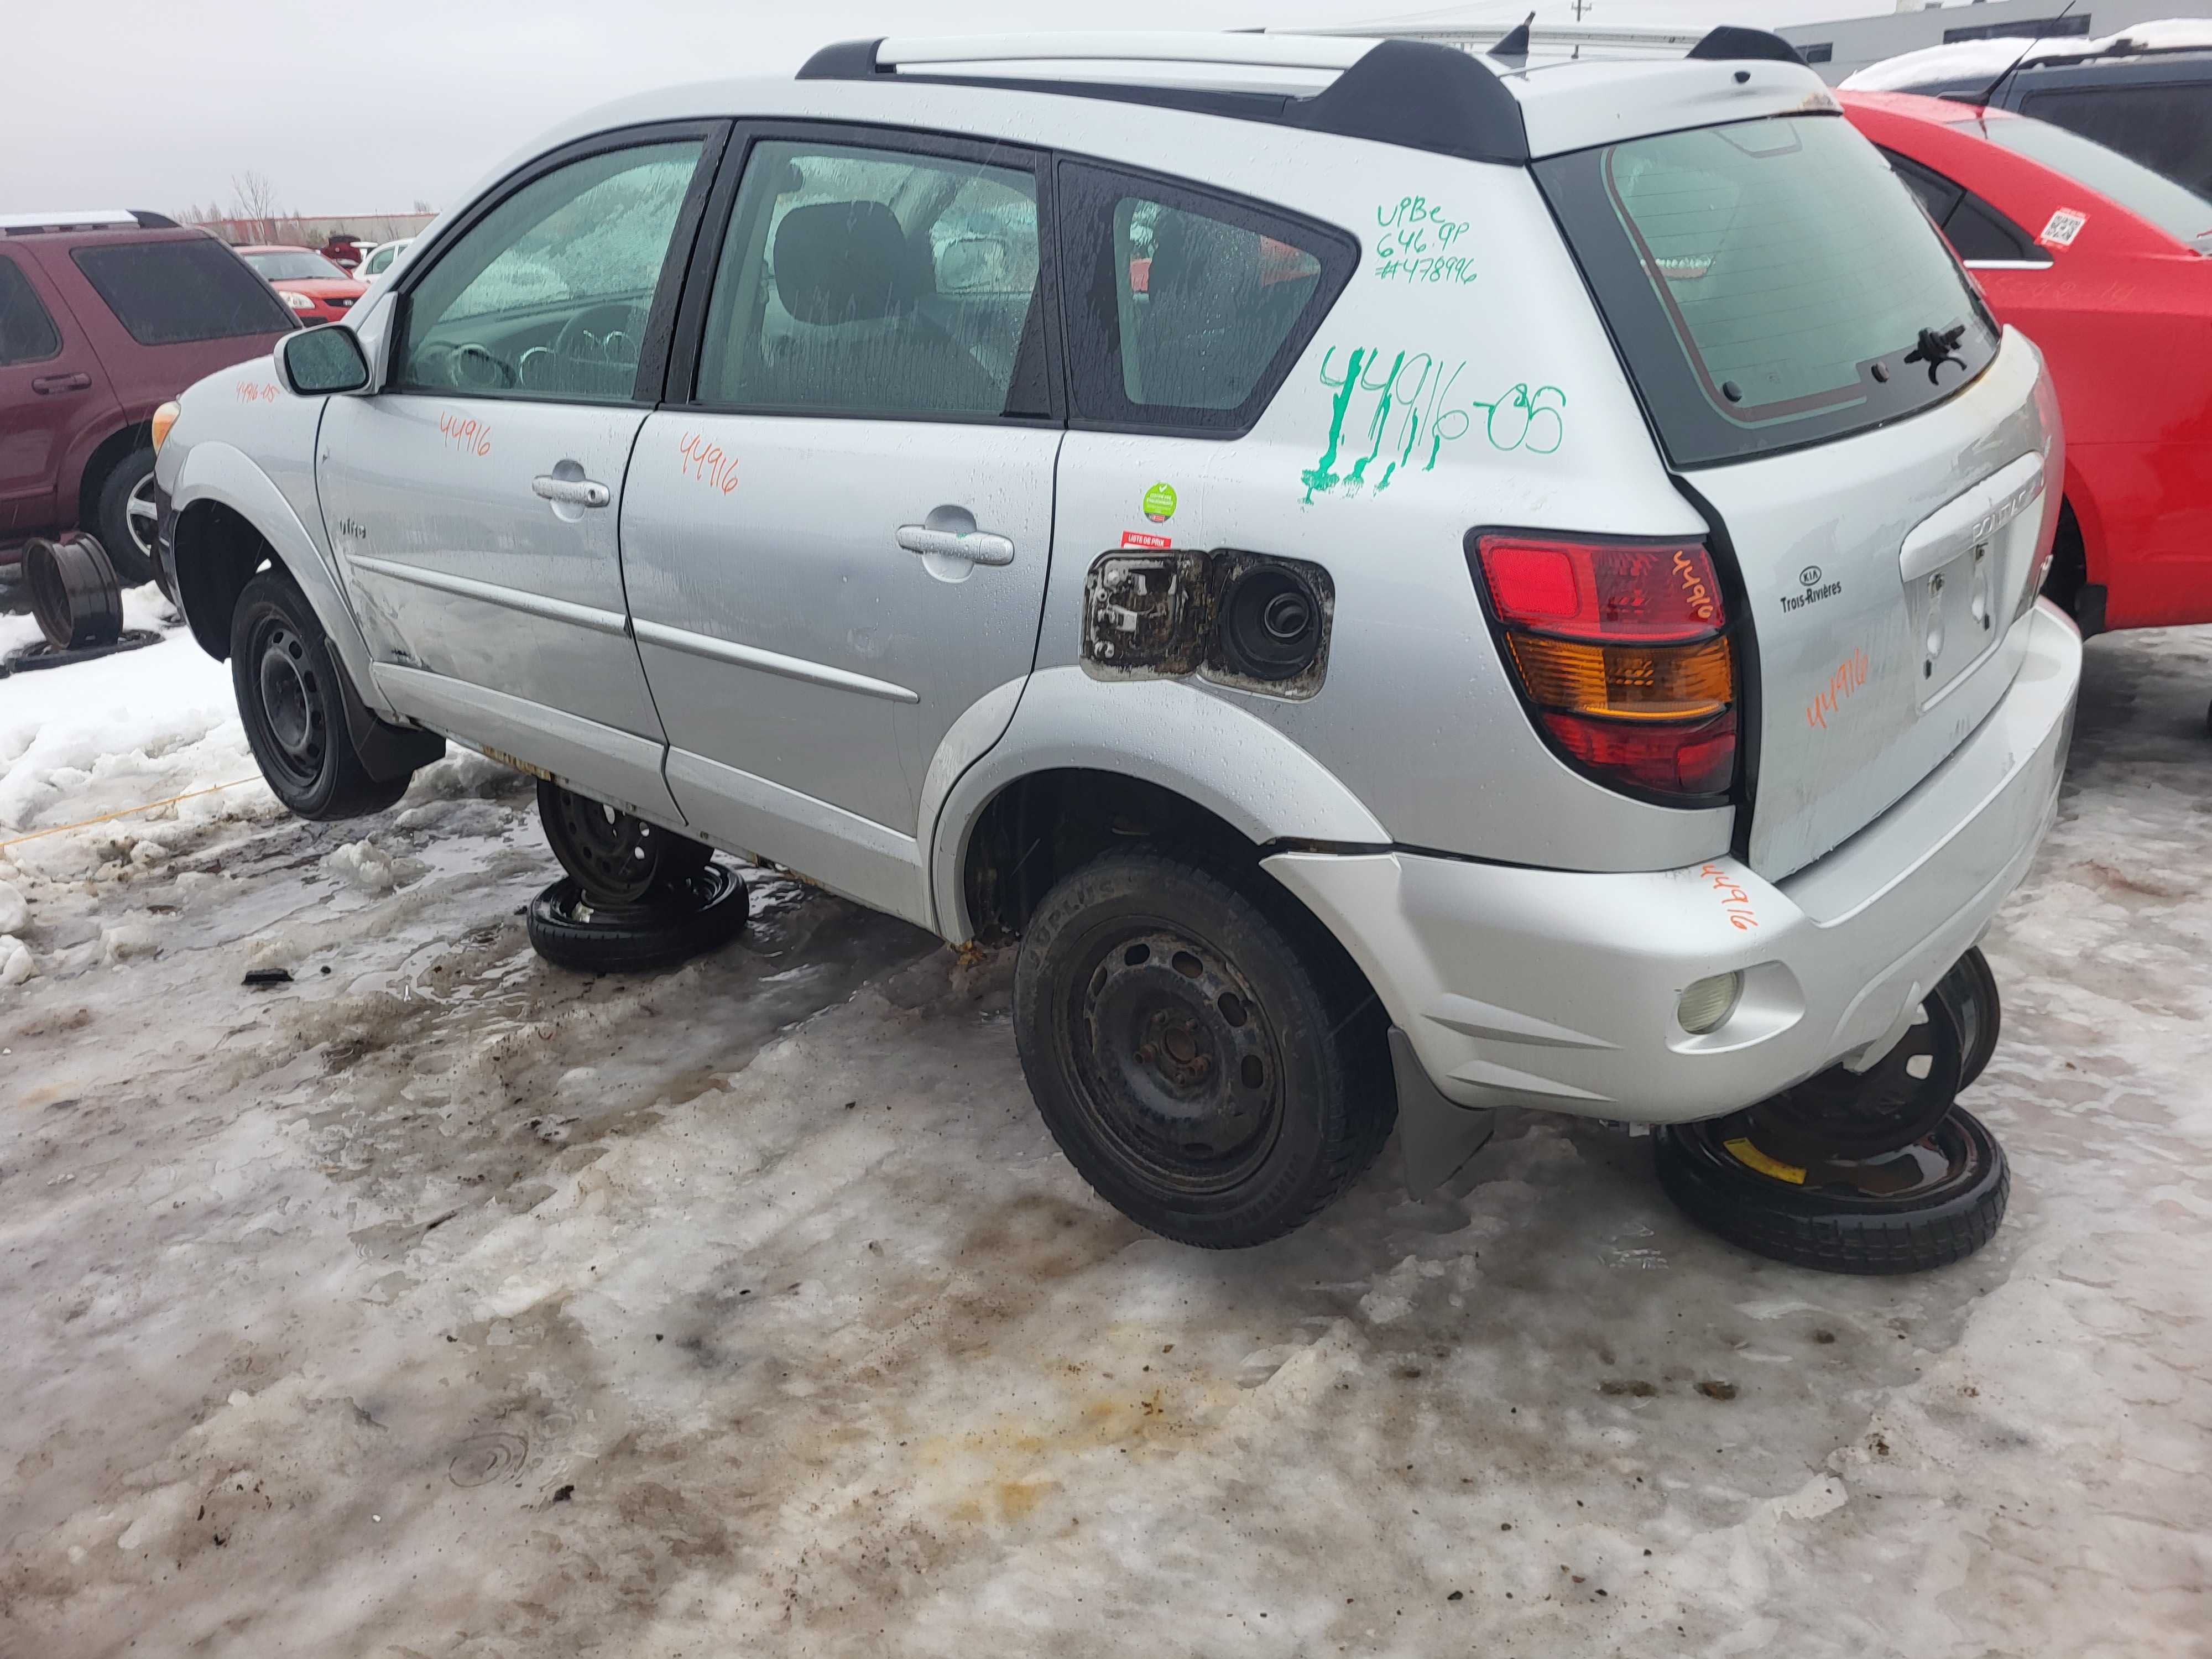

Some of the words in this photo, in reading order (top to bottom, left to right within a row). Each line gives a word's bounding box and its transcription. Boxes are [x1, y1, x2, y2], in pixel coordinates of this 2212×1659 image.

[440, 411, 491, 456] 44916
[680, 432, 738, 495] 44916
[1803, 570, 1819, 582] KIA
[1806, 647, 1869, 729] 44916
[1702, 863, 1760, 932] 44916
